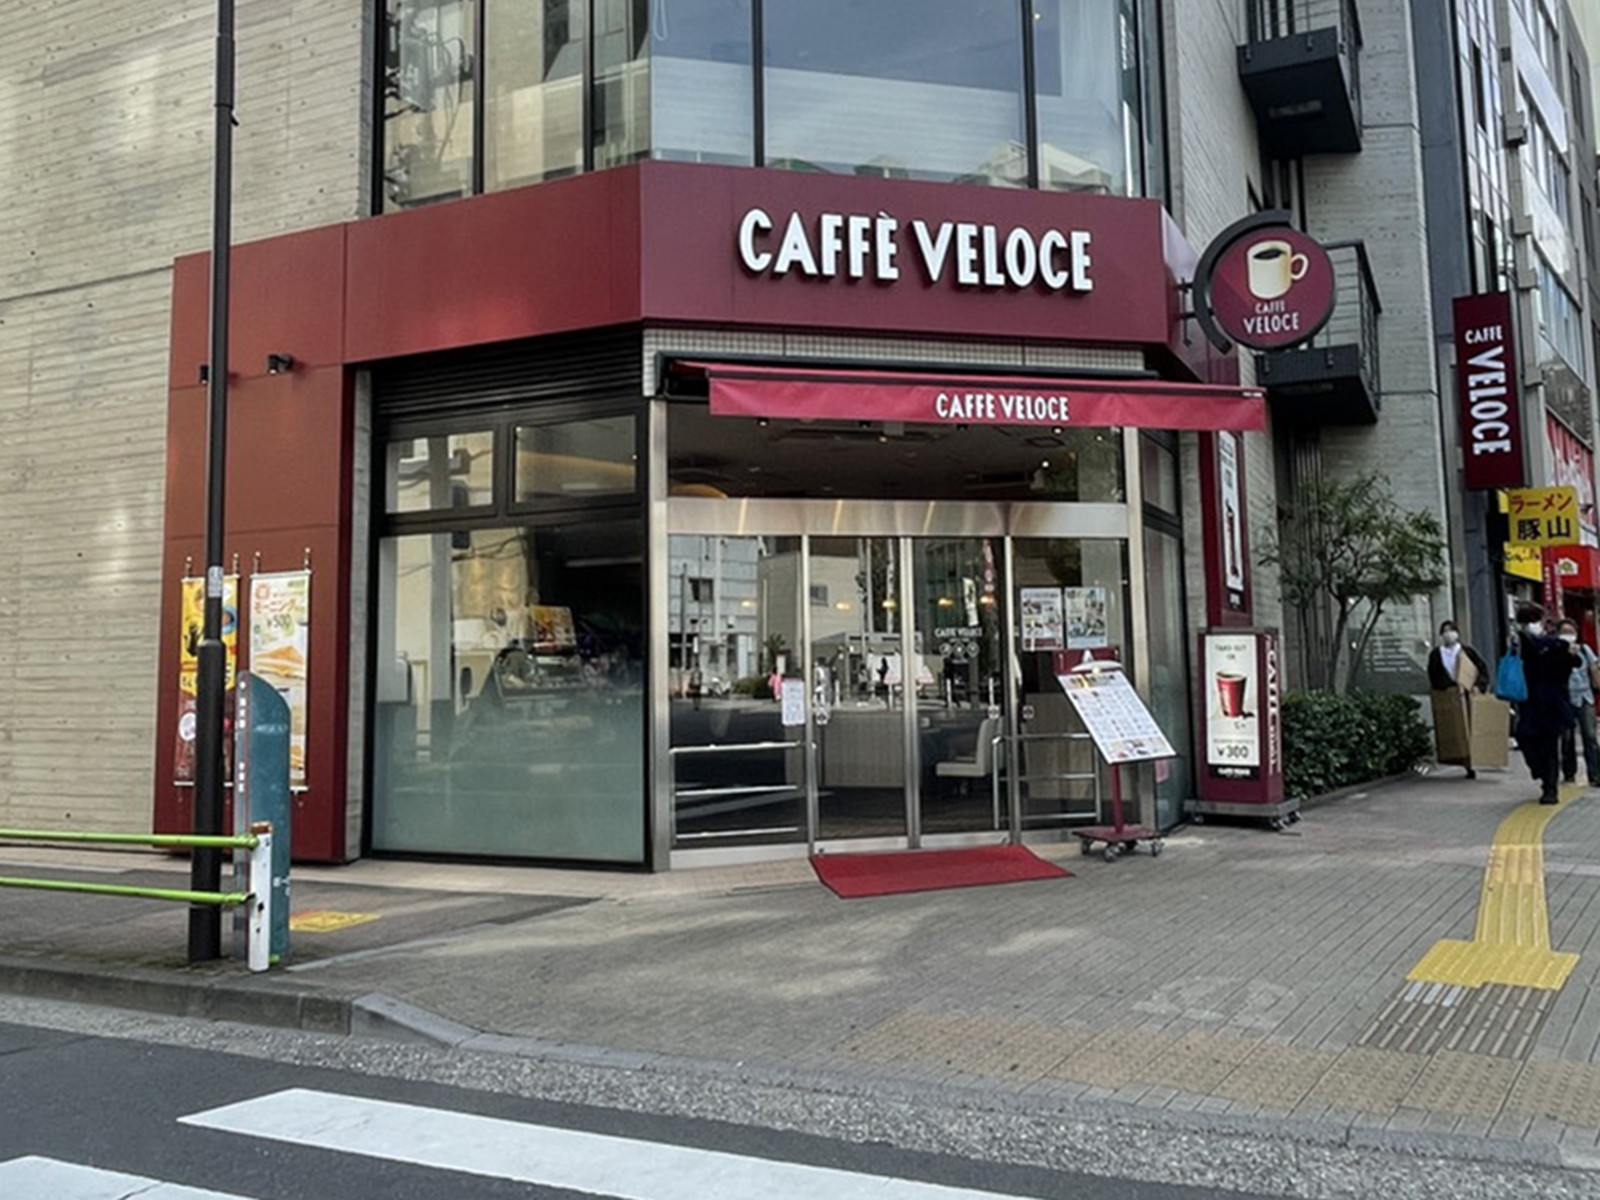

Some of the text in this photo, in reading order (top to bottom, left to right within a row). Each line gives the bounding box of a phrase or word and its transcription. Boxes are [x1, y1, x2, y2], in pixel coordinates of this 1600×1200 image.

[740, 208, 1093, 292] CAFFÈ VELOCE
[1243, 312, 1299, 334] VELOCE
[999, 394, 1069, 420] VELOCE
[1467, 345, 1512, 455] VELOCE
[1511, 493, 1572, 514] ラーメン
[1517, 516, 1571, 540] 豚山
